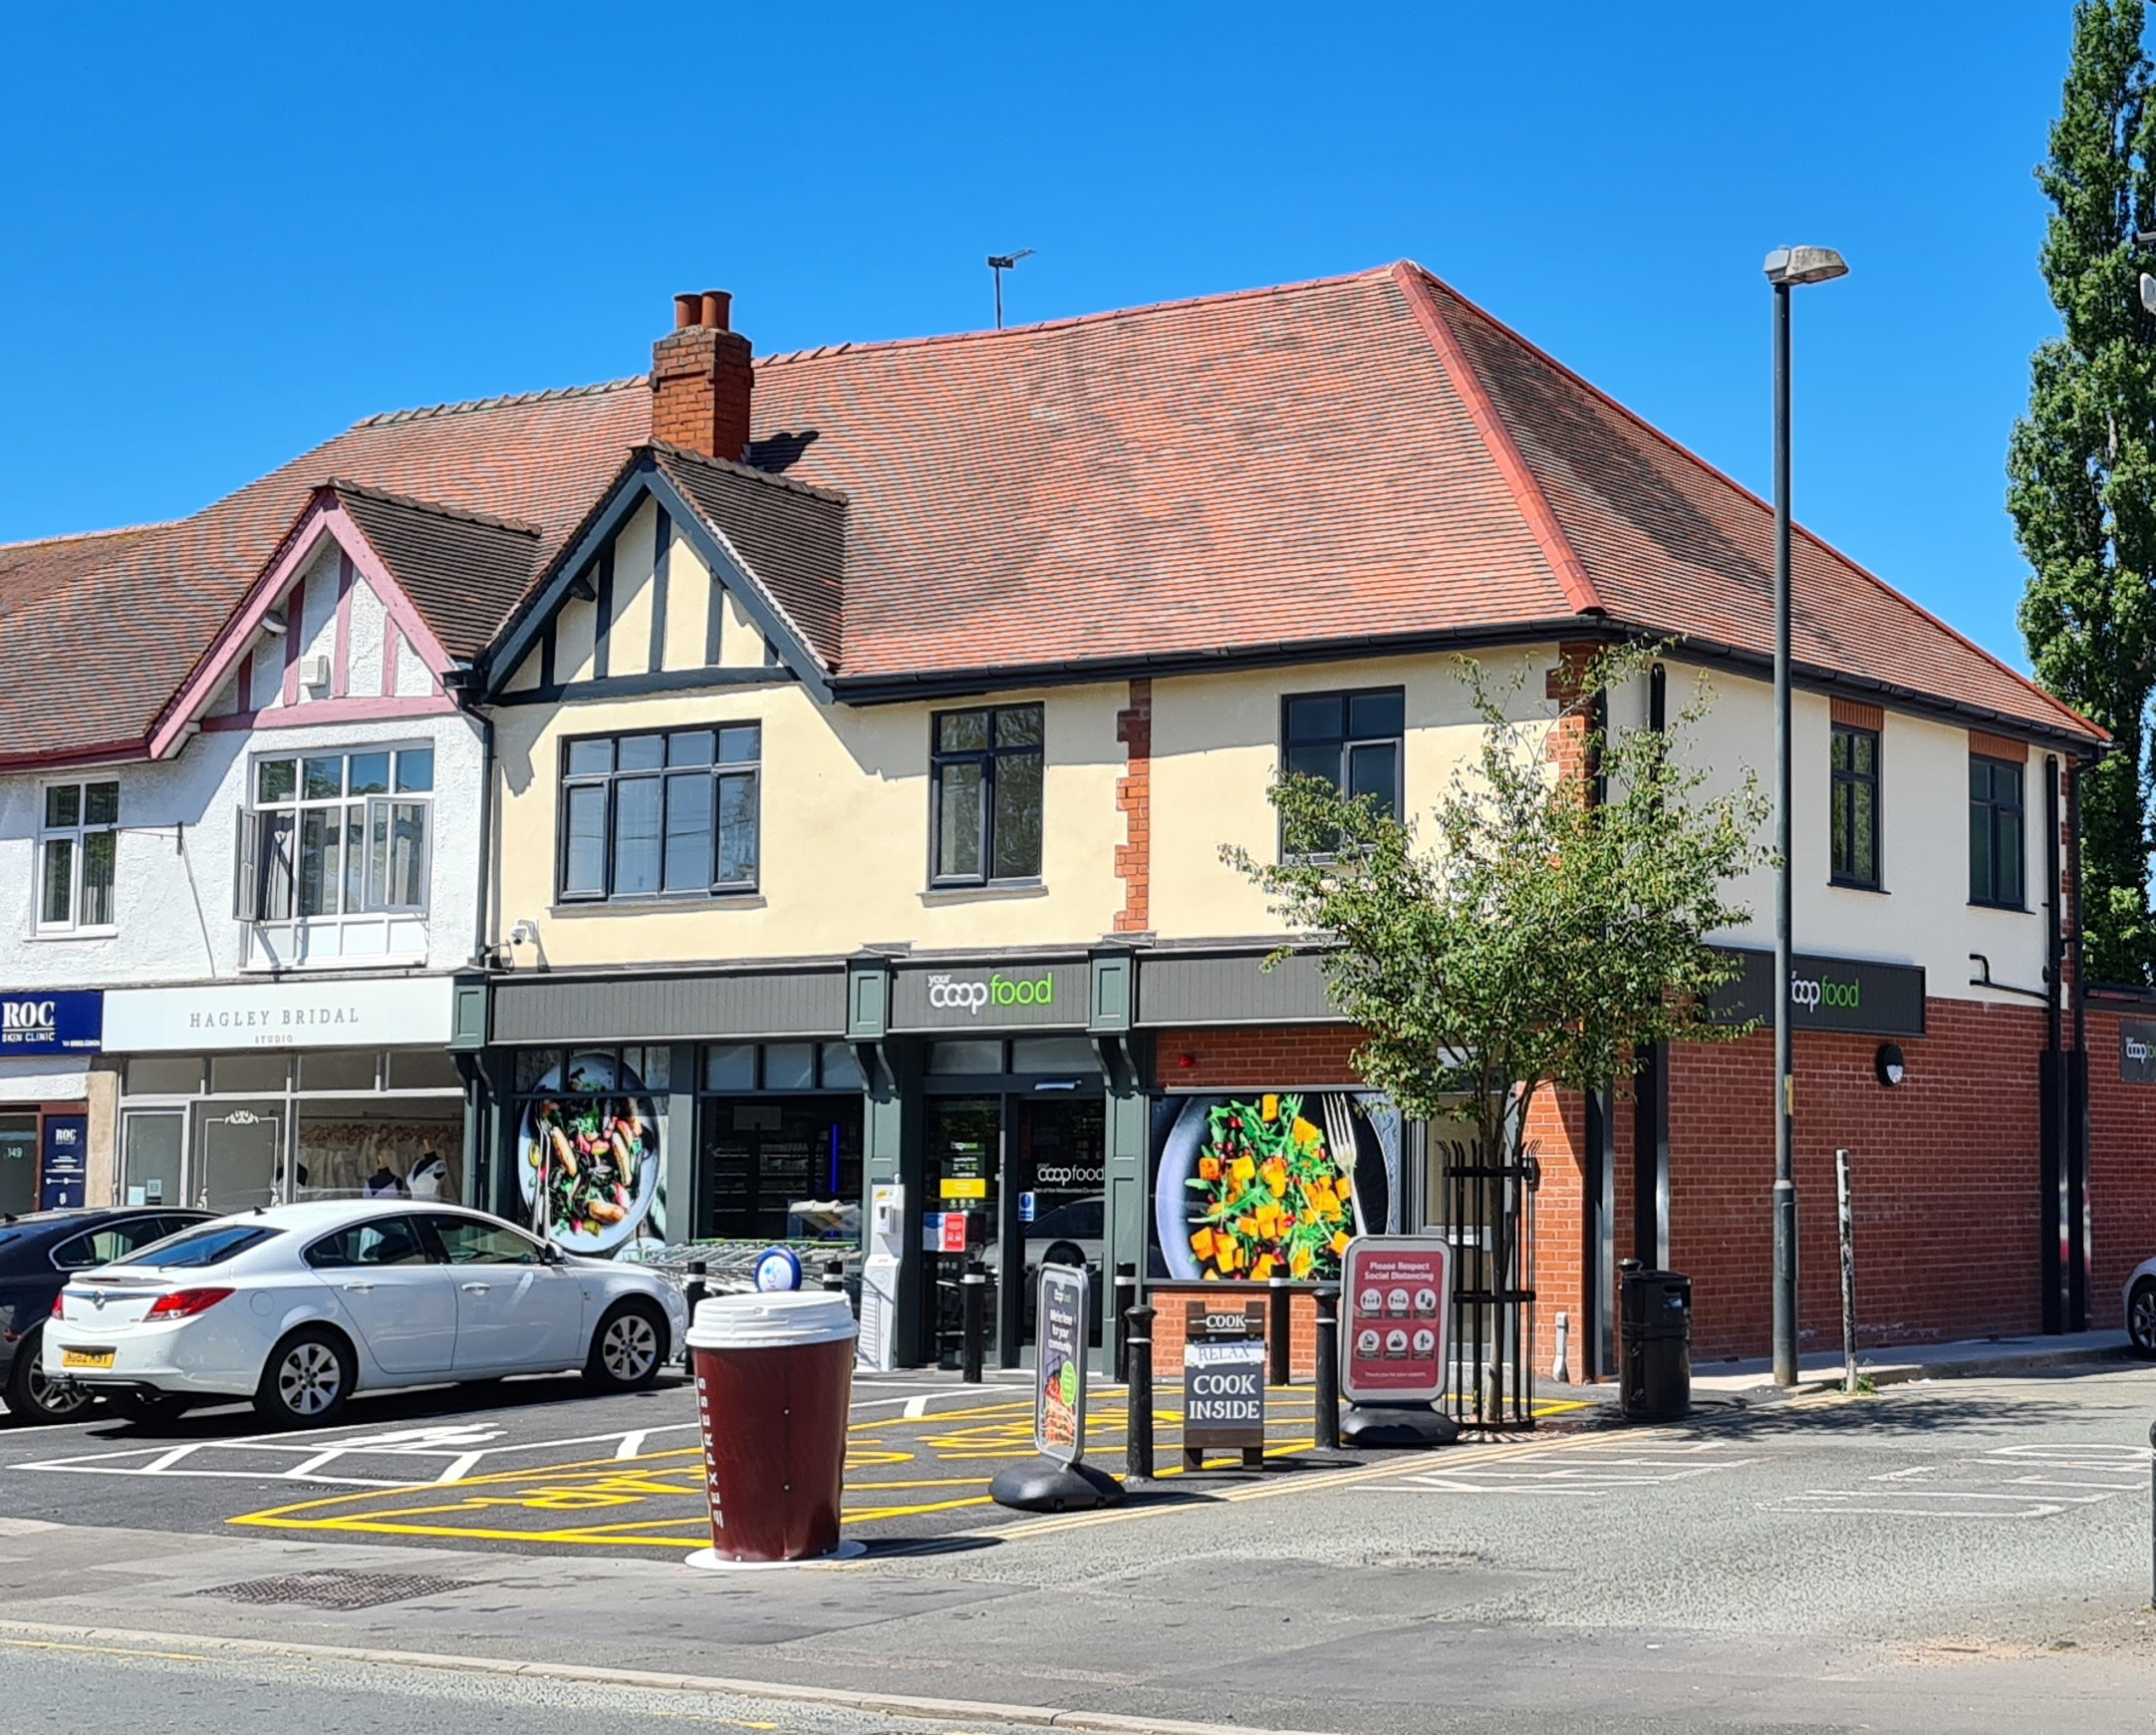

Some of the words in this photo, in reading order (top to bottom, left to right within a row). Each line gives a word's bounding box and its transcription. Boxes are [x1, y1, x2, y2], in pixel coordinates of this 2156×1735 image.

[990, 972, 1053, 1005] food
[1791, 980, 1820, 1012] oop
[1821, 975, 1859, 1008] food
[2, 1002, 56, 1027] ROC
[189, 1011, 270, 1027] HAGLEY
[282, 1008, 360, 1024] BRIDAL
[25, 1032, 56, 1042] CLINIC
[254, 1034, 293, 1043] STUDIO
[56, 1128, 77, 1141] ROC
[7, 1147, 23, 1158] 149
[1071, 1164, 1104, 1181] food
[1369, 1262, 1397, 1271] Please
[1397, 1262, 1431, 1272] Respect
[1364, 1271, 1390, 1281] Social
[1390, 1271, 1435, 1283] Distancing
[1206, 1314, 1246, 1328] COOK
[1199, 1345, 1252, 1362] RELAX
[1193, 1373, 1256, 1395] COOK
[1189, 1399, 1260, 1420] INSIDE
[698, 1377, 721, 1505] EXPRESS
